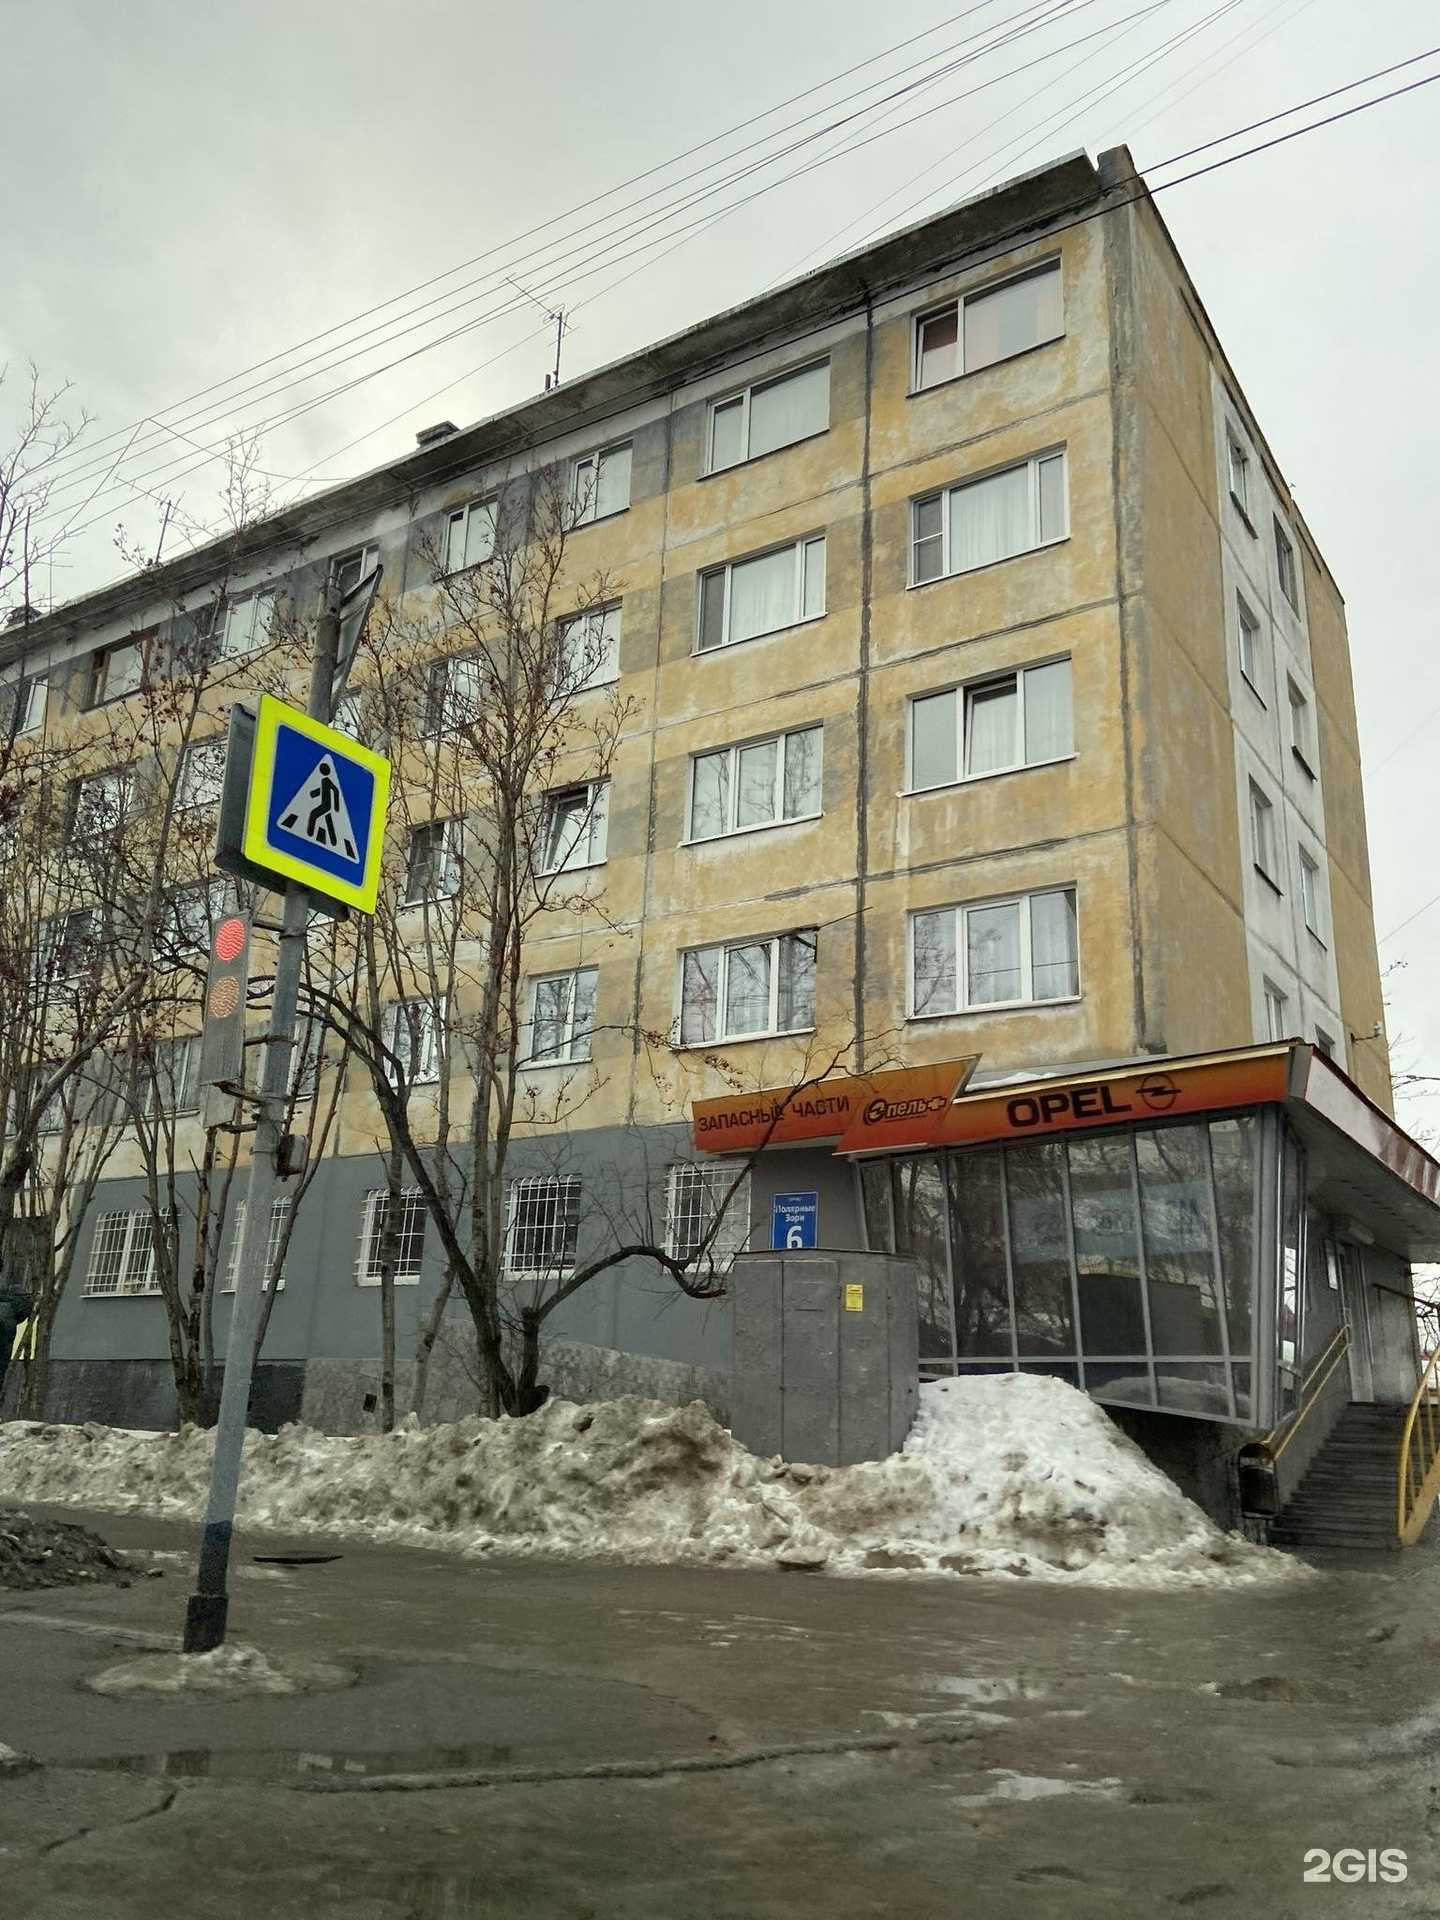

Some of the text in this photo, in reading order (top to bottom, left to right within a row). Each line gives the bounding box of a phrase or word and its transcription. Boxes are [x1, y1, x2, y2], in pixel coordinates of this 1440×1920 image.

[792, 1095, 850, 1118] ЧАСТИ
[1007, 1086, 1131, 1127] OPEL
[787, 1226, 803, 1249] 6
